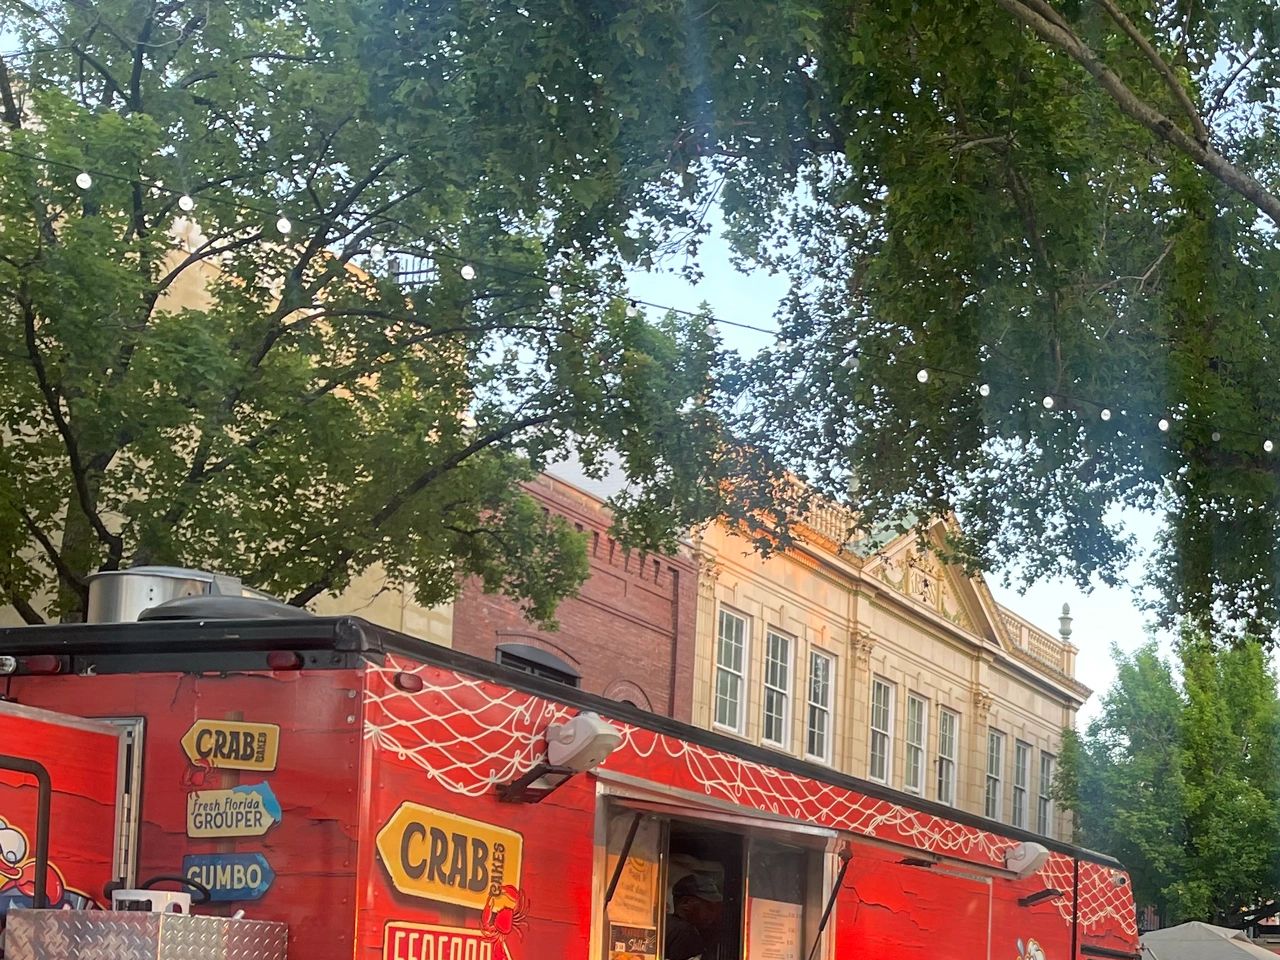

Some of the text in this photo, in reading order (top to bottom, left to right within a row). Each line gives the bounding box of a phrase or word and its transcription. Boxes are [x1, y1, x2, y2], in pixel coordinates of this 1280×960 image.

[195, 728, 255, 762] CRAB
[193, 811, 263, 830] GROUPER
[400, 821, 490, 892] CRAB
[187, 863, 262, 890] GUMBO
